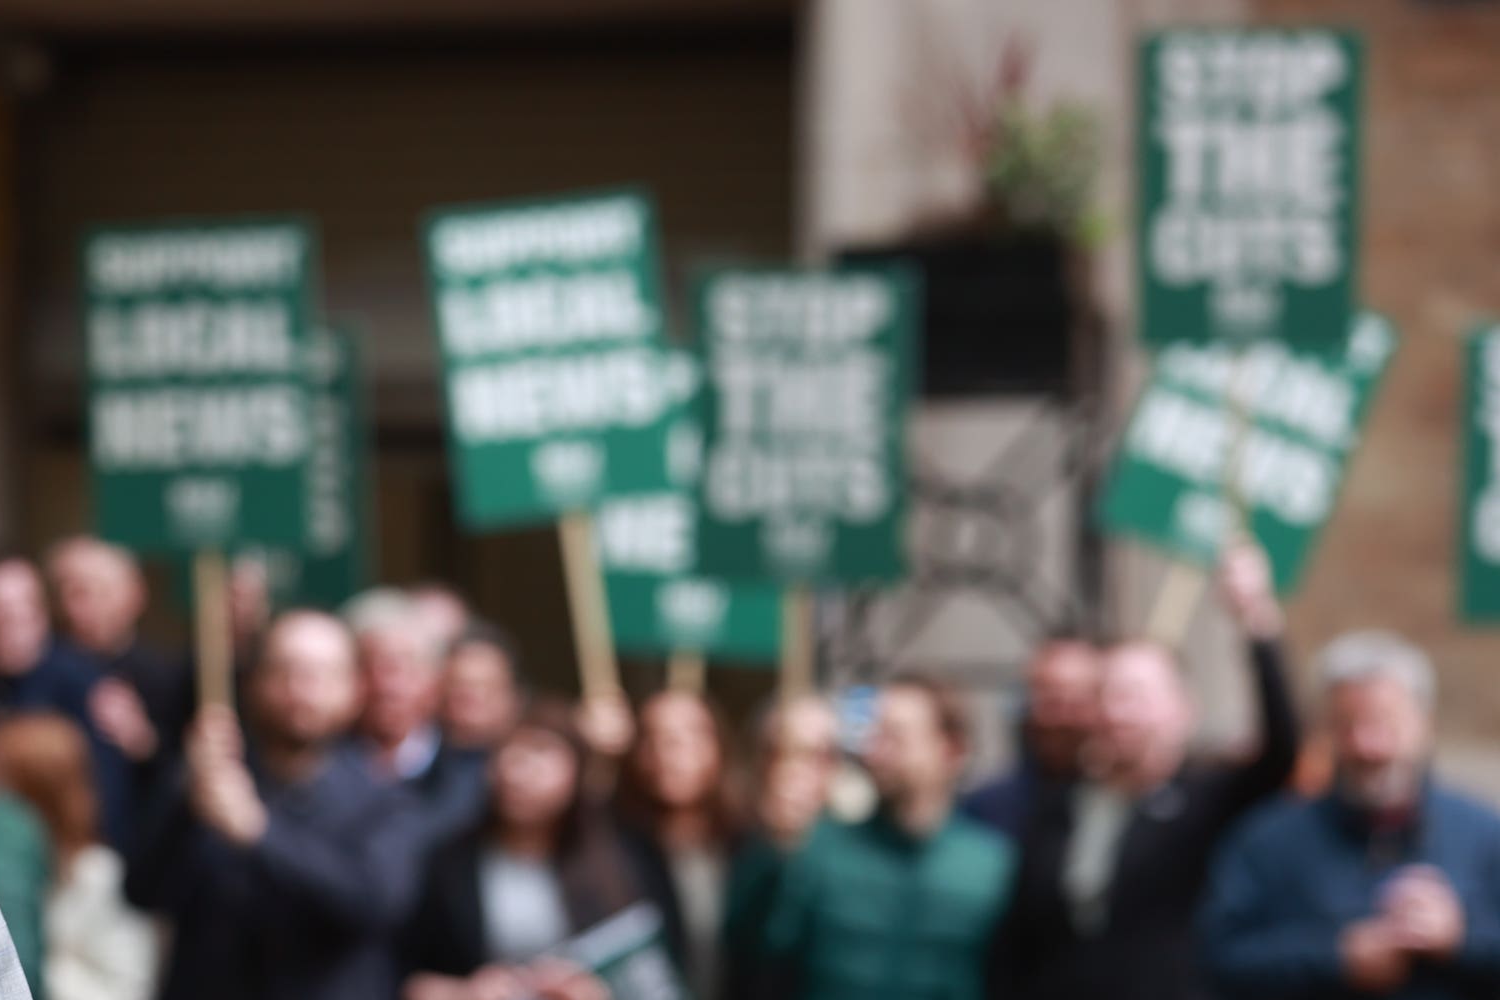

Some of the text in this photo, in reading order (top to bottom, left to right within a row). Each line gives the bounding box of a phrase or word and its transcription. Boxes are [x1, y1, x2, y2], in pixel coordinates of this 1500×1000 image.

[1154, 30, 1348, 106] STOP
[1156, 107, 1344, 208] THE
[88, 224, 304, 294] SUPPORT
[430, 197, 642, 276] SUPPORT
[1150, 208, 1340, 287] CUTS
[90, 300, 302, 380] LOCAL
[438, 270, 660, 357] LOCAL
[708, 272, 900, 342] STOP
[94, 386, 306, 470] NEWS
[448, 346, 664, 446] NEWS
[710, 340, 890, 452] THE
[706, 446, 894, 522] CUTS
